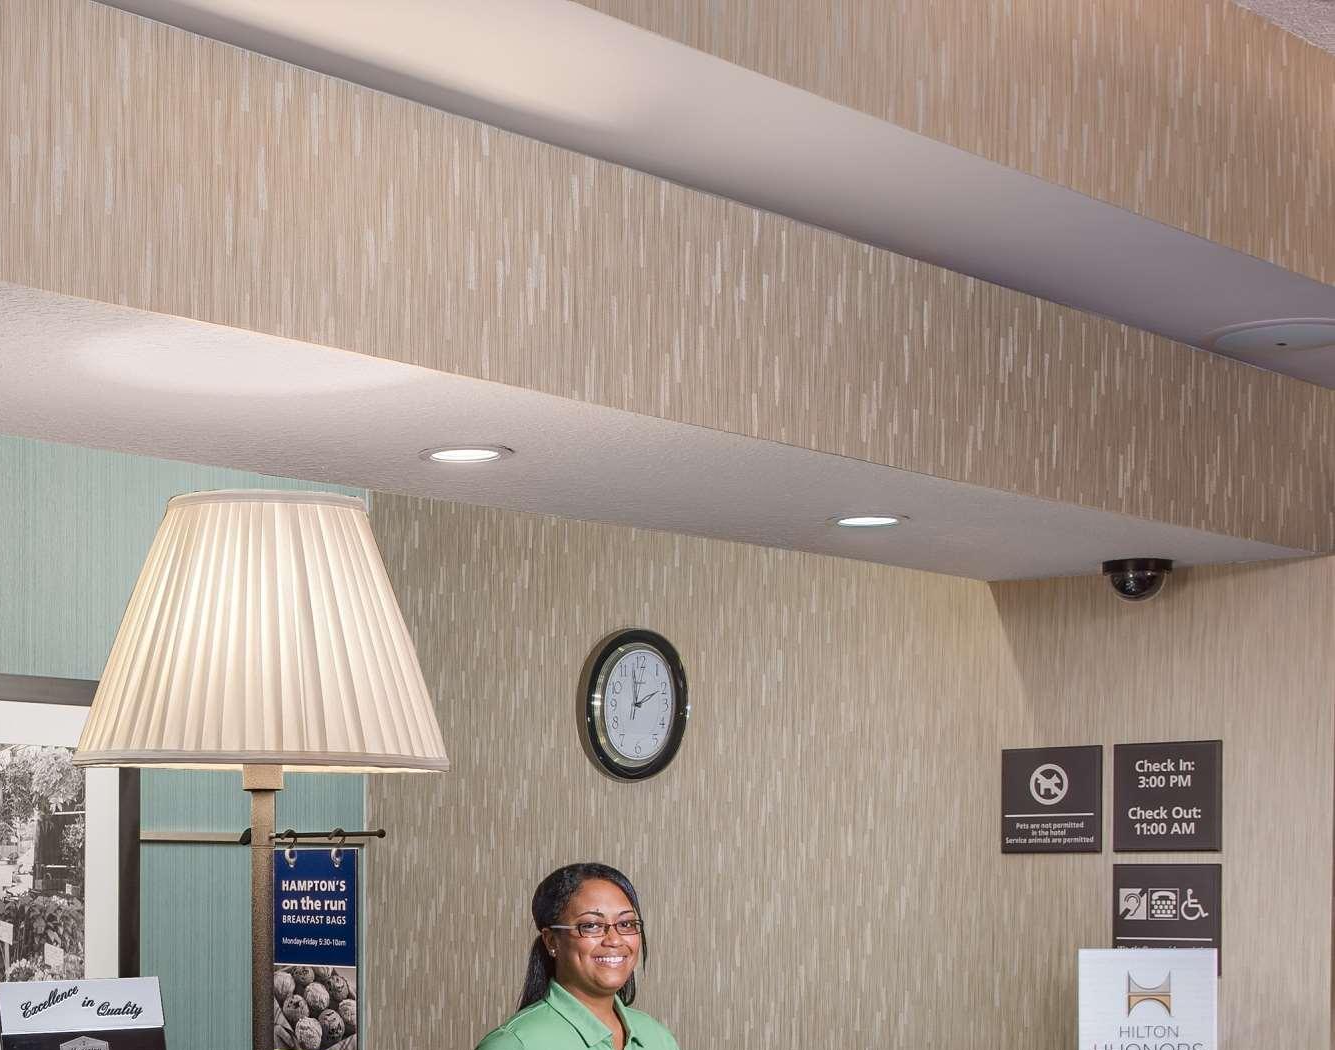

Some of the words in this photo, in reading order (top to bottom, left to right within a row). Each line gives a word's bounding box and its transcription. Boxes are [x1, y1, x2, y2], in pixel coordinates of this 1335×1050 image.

[636, 655, 646, 669] 12
[620, 664, 627, 677] 11
[612, 680, 622, 694] 10
[1135, 759, 1175, 773] Check
[1179, 758, 1195, 772] In:
[1137, 775, 1166, 788] 3:00
[1169, 775, 1192, 787] PM
[1127, 806, 1167, 820] Check
[1171, 806, 1202, 819] Out:
[1016, 822, 1029, 830] Pets
[1052, 821, 1084, 830] permitted
[1038, 828, 1049, 836] the
[1049, 828, 1066, 836] hotel
[1134, 822, 1166, 835] 11:00
[1170, 822, 1195, 835] AM
[1005, 836, 1027, 844] Service
[1028, 836, 1051, 844] animals
[1062, 835, 1094, 845] permitted
[281, 880, 347, 892] HAMPTON'S
[281, 898, 299, 911] on
[300, 896, 322, 911] the
[282, 914, 324, 925] BREAKFAST
[325, 915, 347, 925] BAGS
[20, 986, 79, 1019] Excellence
[81, 996, 96, 1008] in
[96, 1001, 144, 1020] Quality
[1119, 1025, 1179, 1039] HILTON
